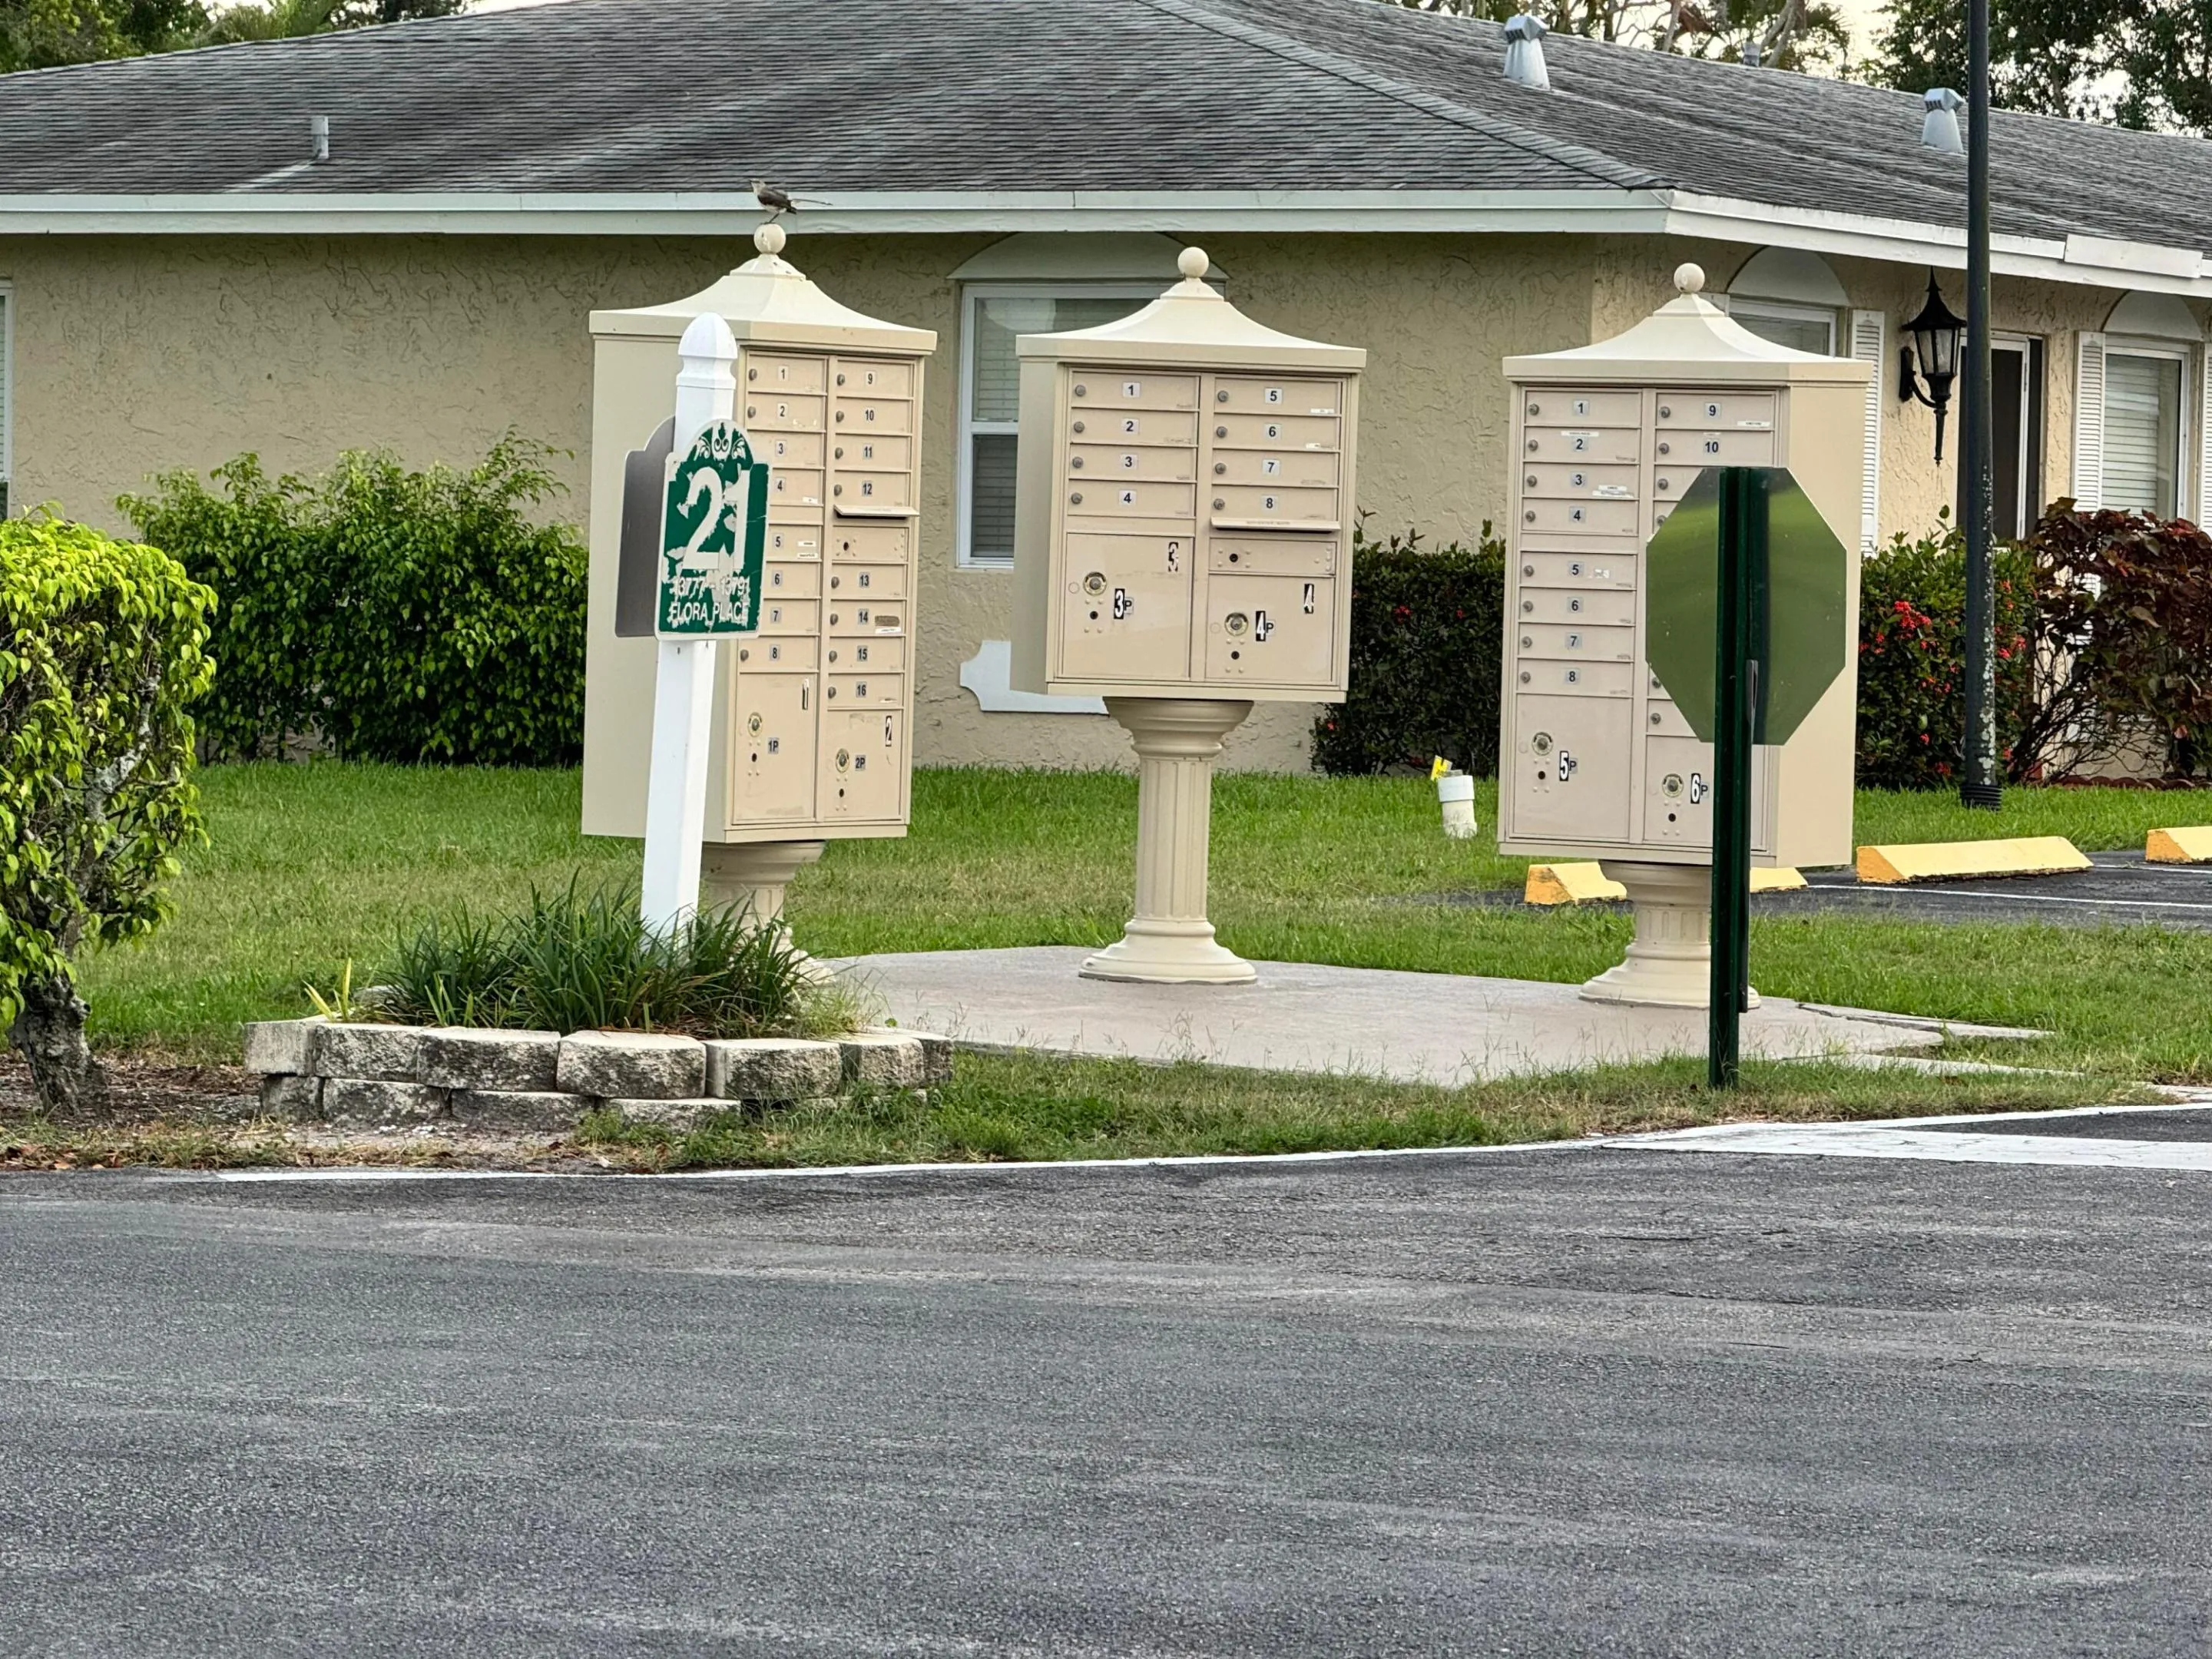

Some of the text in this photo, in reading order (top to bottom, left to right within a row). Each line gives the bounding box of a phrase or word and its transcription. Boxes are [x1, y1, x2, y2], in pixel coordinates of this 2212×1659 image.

[780, 368, 786, 379] 1
[867, 373, 873, 385] 9
[1128, 384, 1134, 396] 1
[1270, 390, 1277, 402] 5
[780, 405, 786, 418] 2
[1578, 402, 1584, 414] 1
[1709, 405, 1717, 417] 9
[865, 409, 875, 422] 10
[1125, 420, 1134, 432] 2
[1268, 426, 1277, 438] 6
[778, 442, 784, 455] 3
[1575, 438, 1584, 450] 2
[1704, 441, 1719, 453] 10
[864, 445, 873, 459] 11
[1124, 455, 1133, 468] 3
[1267, 462, 1275, 473] 7
[777, 480, 783, 492] 4
[1575, 474, 1583, 486] 3
[863, 482, 873, 495] 12
[1123, 492, 1132, 504] 4
[1266, 497, 1273, 509] 8
[680, 465, 750, 571] 21
[1573, 509, 1581, 522] 4
[775, 535, 781, 548] 5
[1168, 542, 1178, 571] 3
[1571, 564, 1579, 576] 5
[774, 573, 780, 585] 6
[859, 575, 869, 587] 13
[1114, 589, 1132, 618] 3P
[1304, 584, 1314, 614] 4
[1571, 599, 1579, 611] 6
[671, 601, 749, 624] FLORA PLACE
[773, 610, 779, 622] 7
[858, 611, 869, 623] 14
[1256, 611, 1274, 641] 4P
[1570, 635, 1578, 647] 7
[772, 647, 778, 659] 8
[857, 647, 868, 661] 15
[1568, 671, 1576, 683] 8
[856, 684, 866, 697] 16
[886, 716, 892, 747] 2
[768, 740, 779, 753] 1P
[855, 757, 866, 769] 2P
[1560, 751, 1577, 780] 5P
[1691, 773, 1708, 803] 6P
